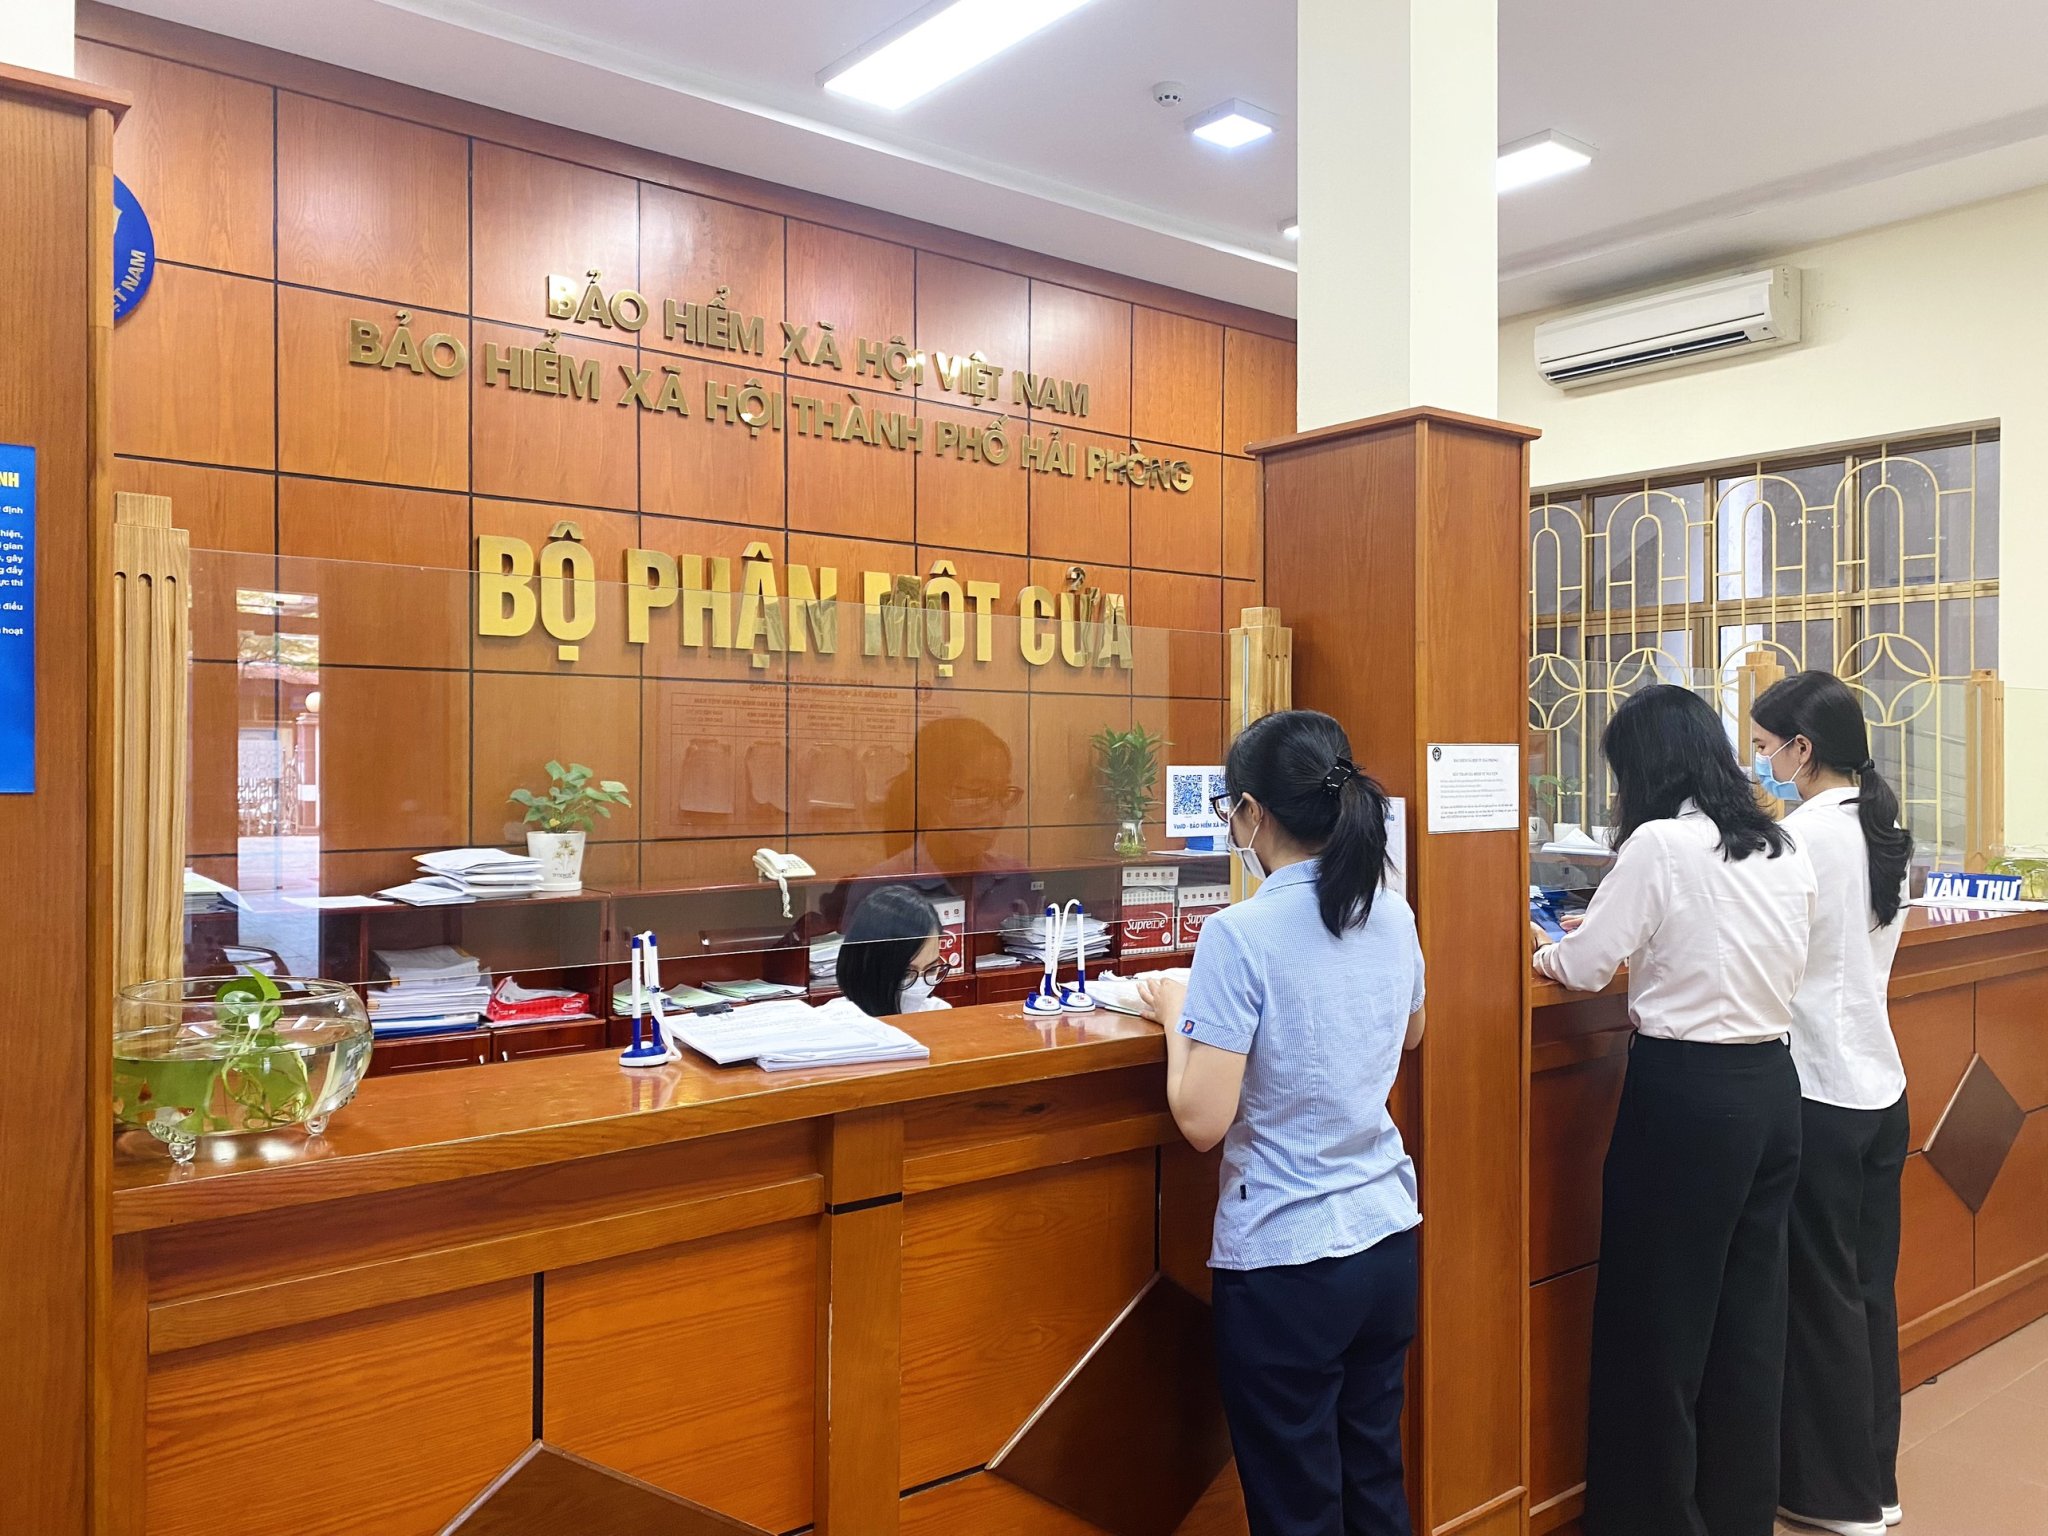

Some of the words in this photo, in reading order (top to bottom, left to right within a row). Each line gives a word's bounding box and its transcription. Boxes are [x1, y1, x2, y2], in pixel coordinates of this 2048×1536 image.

[121, 249, 146, 292] NAM
[547, 268, 649, 331] BẢO
[665, 285, 765, 355] HIỂM
[780, 320, 843, 370] XÃ
[856, 336, 924, 390] HỘI
[935, 350, 1003, 406] VIỆT
[1014, 369, 1090, 417] NAM
[348, 309, 466, 378] BẢO
[484, 328, 601, 402] HIỂM
[619, 365, 691, 416] XÃ
[705, 378, 784, 436] HỘI
[792, 392, 924, 453] THÀNH
[935, 414, 1010, 466] PHỐ
[1021, 428, 1076, 477] HẢI
[1086, 439, 1195, 494] PHÒNG
[2, 542, 24, 551] gian
[478, 521, 596, 662] BỘ
[624, 541, 838, 669] PHẬN
[863, 560, 1000, 679] MỘT
[1019, 566, 1133, 669] CỬA
[1926, 872, 1970, 900] VĂN
[1976, 878, 2023, 901] THƯ
[1126, 918, 1166, 934] Supreme
[1186, 913, 1208, 928] Supr
